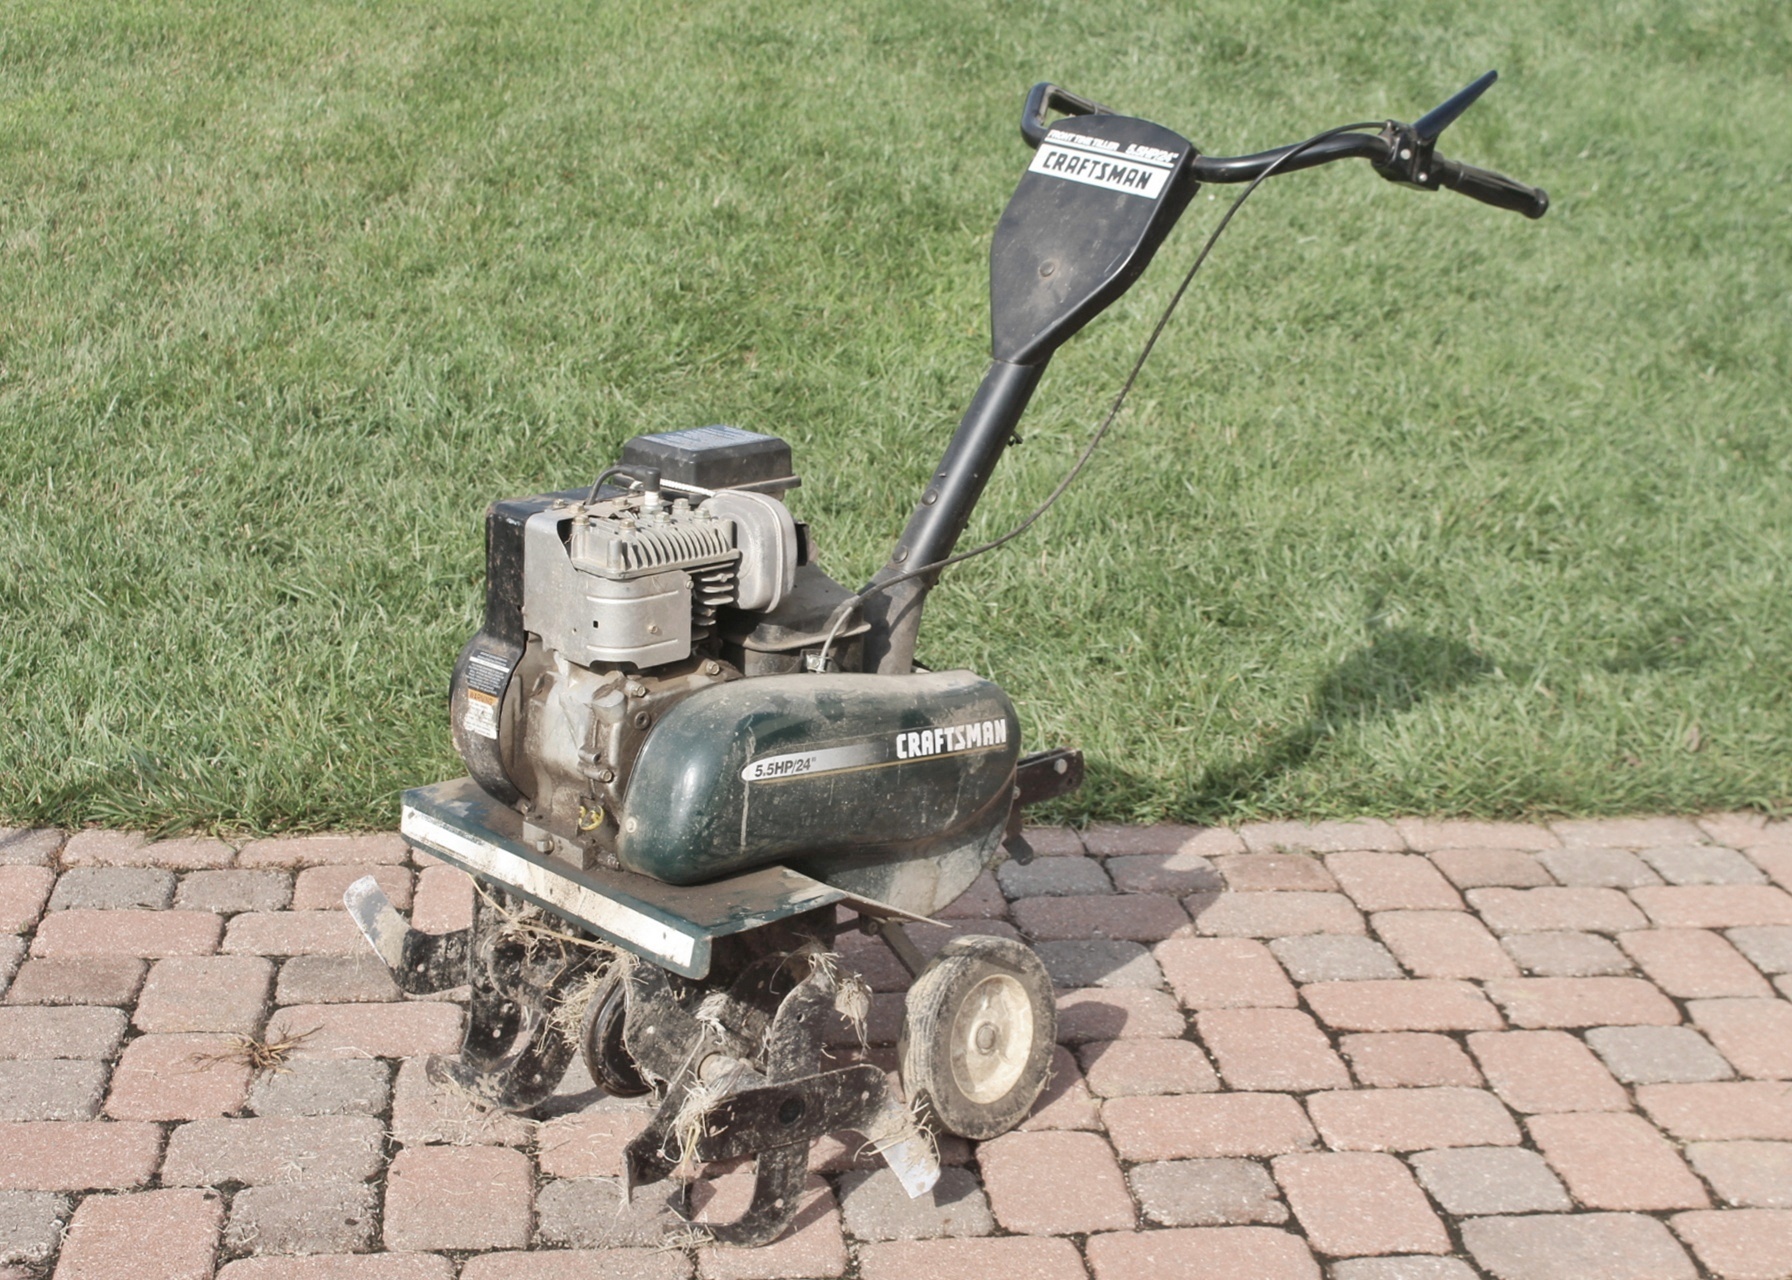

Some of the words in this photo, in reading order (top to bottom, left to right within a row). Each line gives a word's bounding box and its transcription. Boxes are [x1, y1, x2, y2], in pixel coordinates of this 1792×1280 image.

[1048, 129, 1075, 142] FRONT
[1092, 137, 1120, 151] TILLER
[1042, 151, 1152, 190] CRAFTSMAN
[896, 718, 1007, 759] CRAFTSMAN
